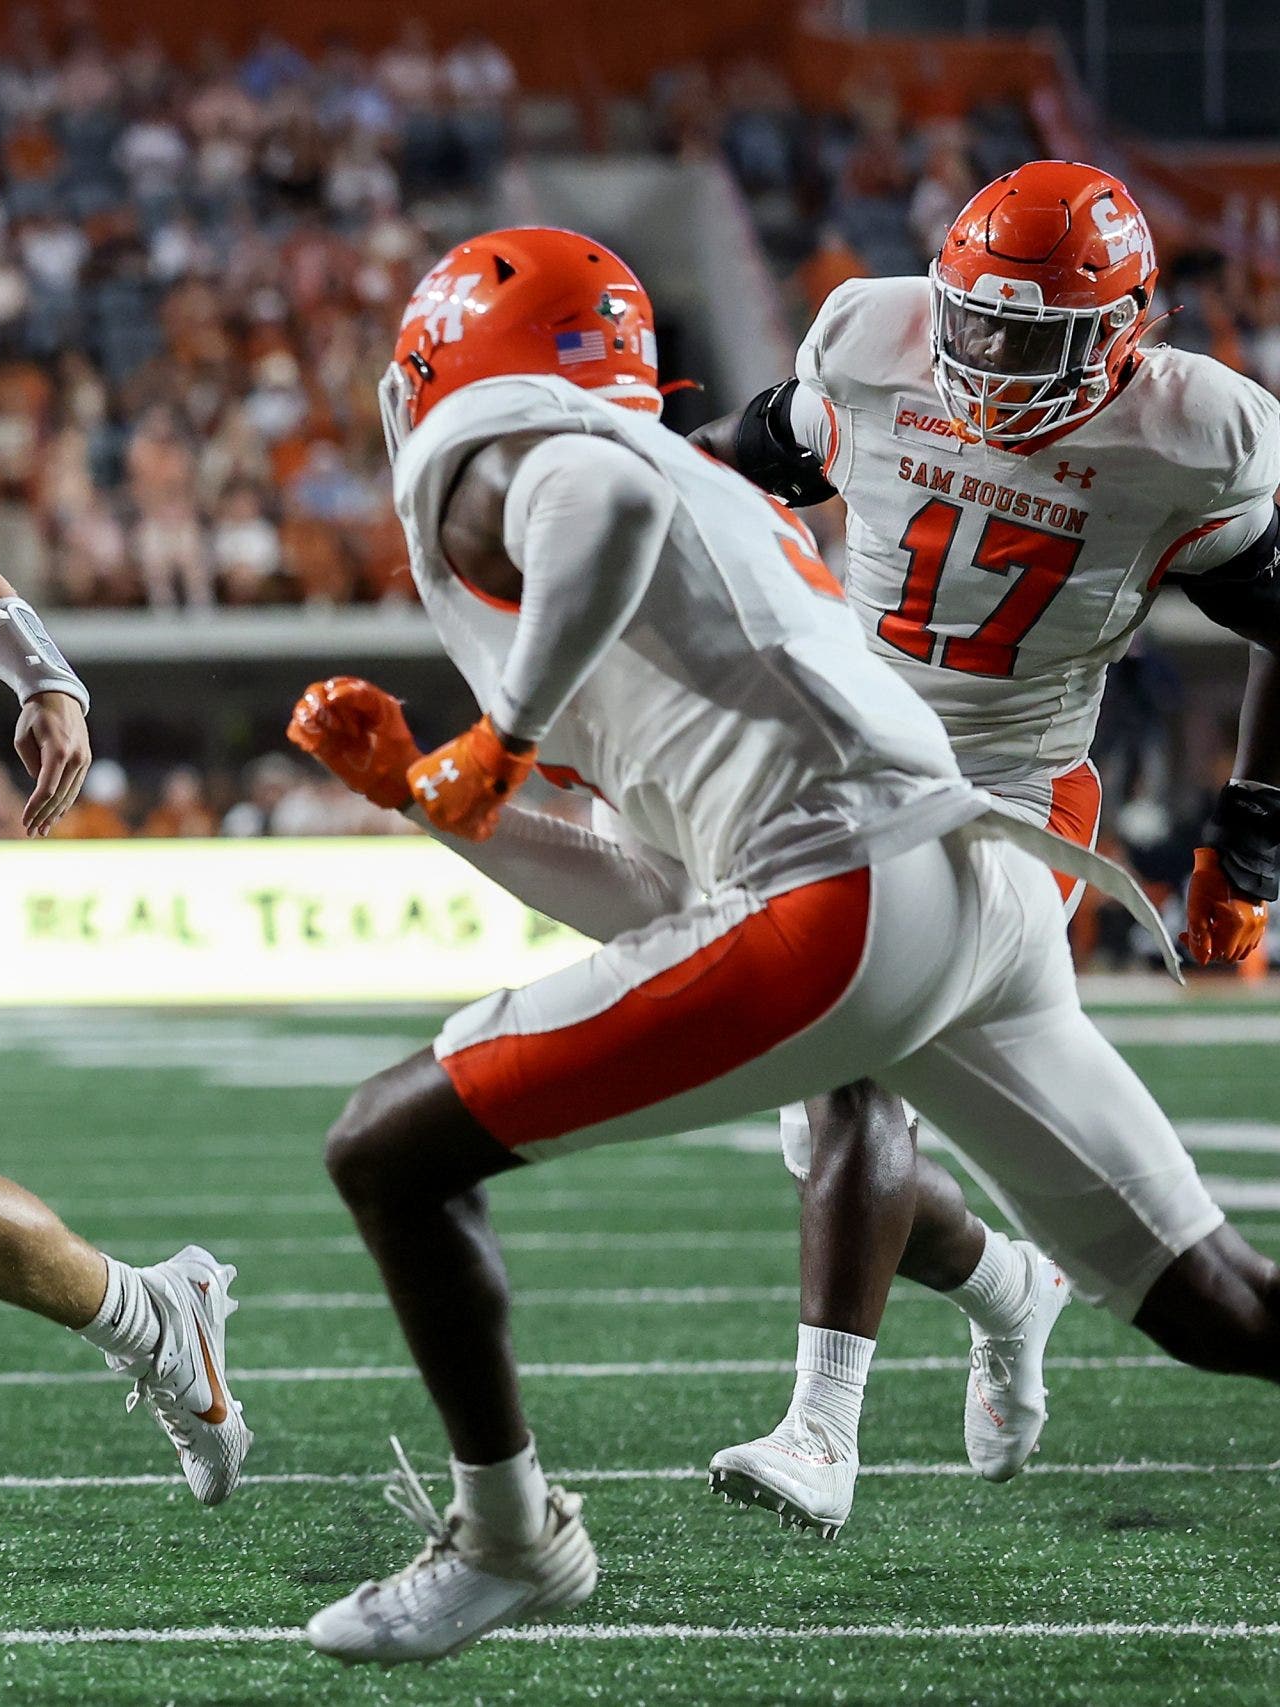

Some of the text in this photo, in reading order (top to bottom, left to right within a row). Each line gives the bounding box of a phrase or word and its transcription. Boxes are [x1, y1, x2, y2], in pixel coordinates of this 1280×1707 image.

[898, 456, 1089, 534] SAM HOUSTON
[877, 496, 1086, 677] 17
